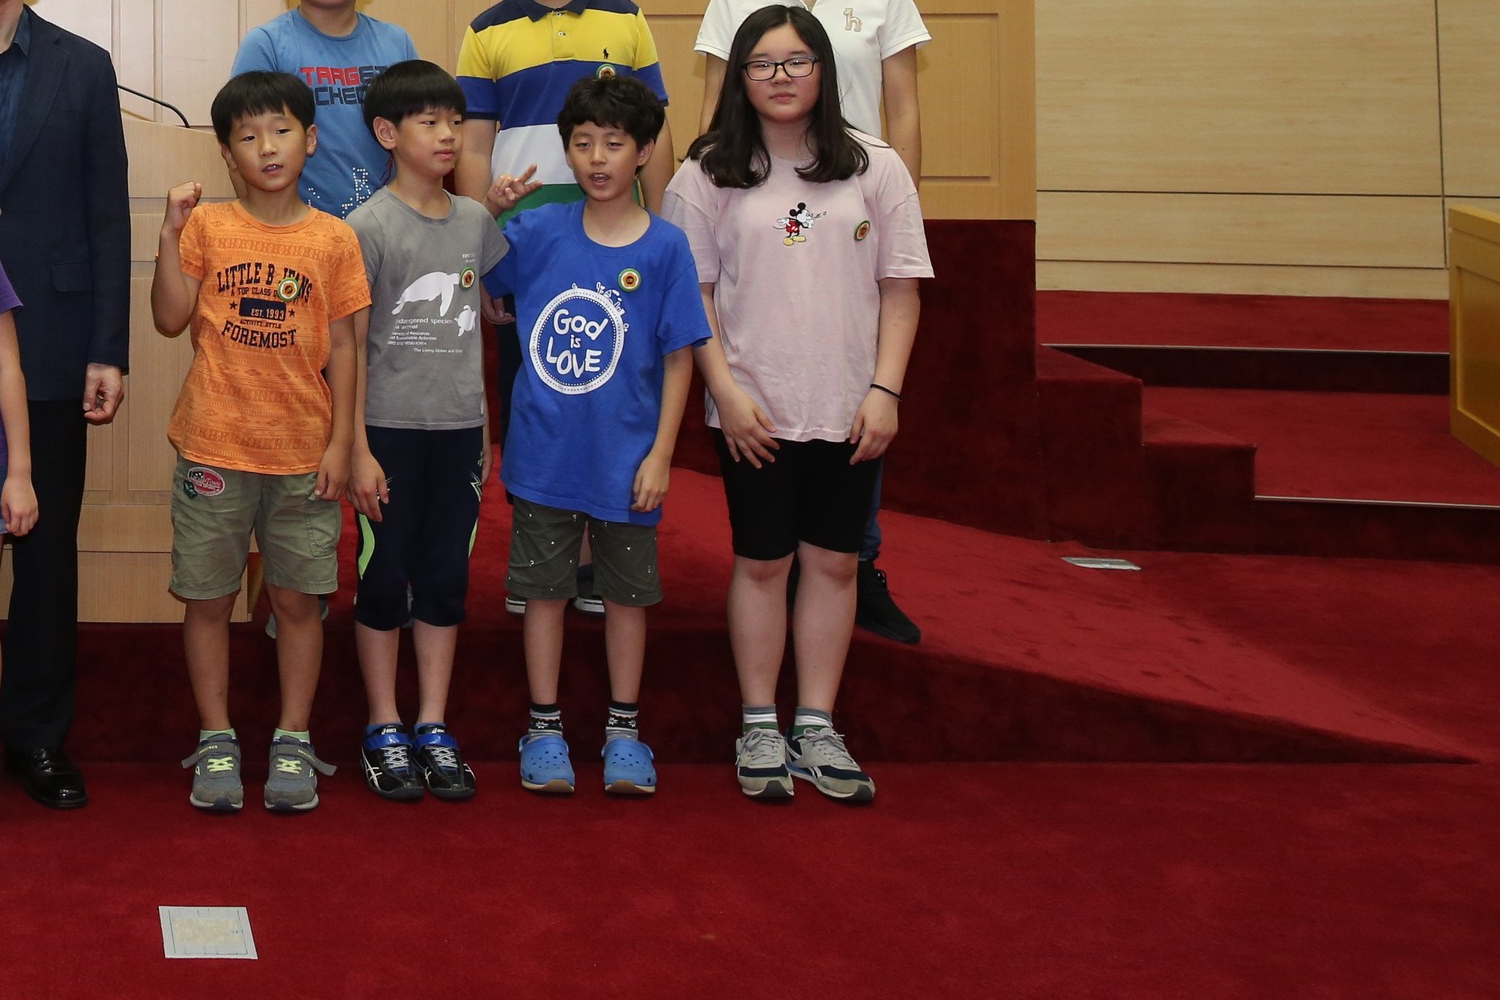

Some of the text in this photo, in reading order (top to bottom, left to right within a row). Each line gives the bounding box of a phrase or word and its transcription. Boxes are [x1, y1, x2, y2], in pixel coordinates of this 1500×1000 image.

[217, 263, 262, 293] LITTLE
[266, 264, 275, 285] B
[238, 287, 249, 295] TOP
[252, 287, 271, 296] CLASS
[251, 308, 285, 320] EST. 1993
[554, 309, 608, 340] God
[222, 320, 296, 348] FOREMOST
[570, 334, 581, 348] is
[546, 336, 602, 378] LOVE
